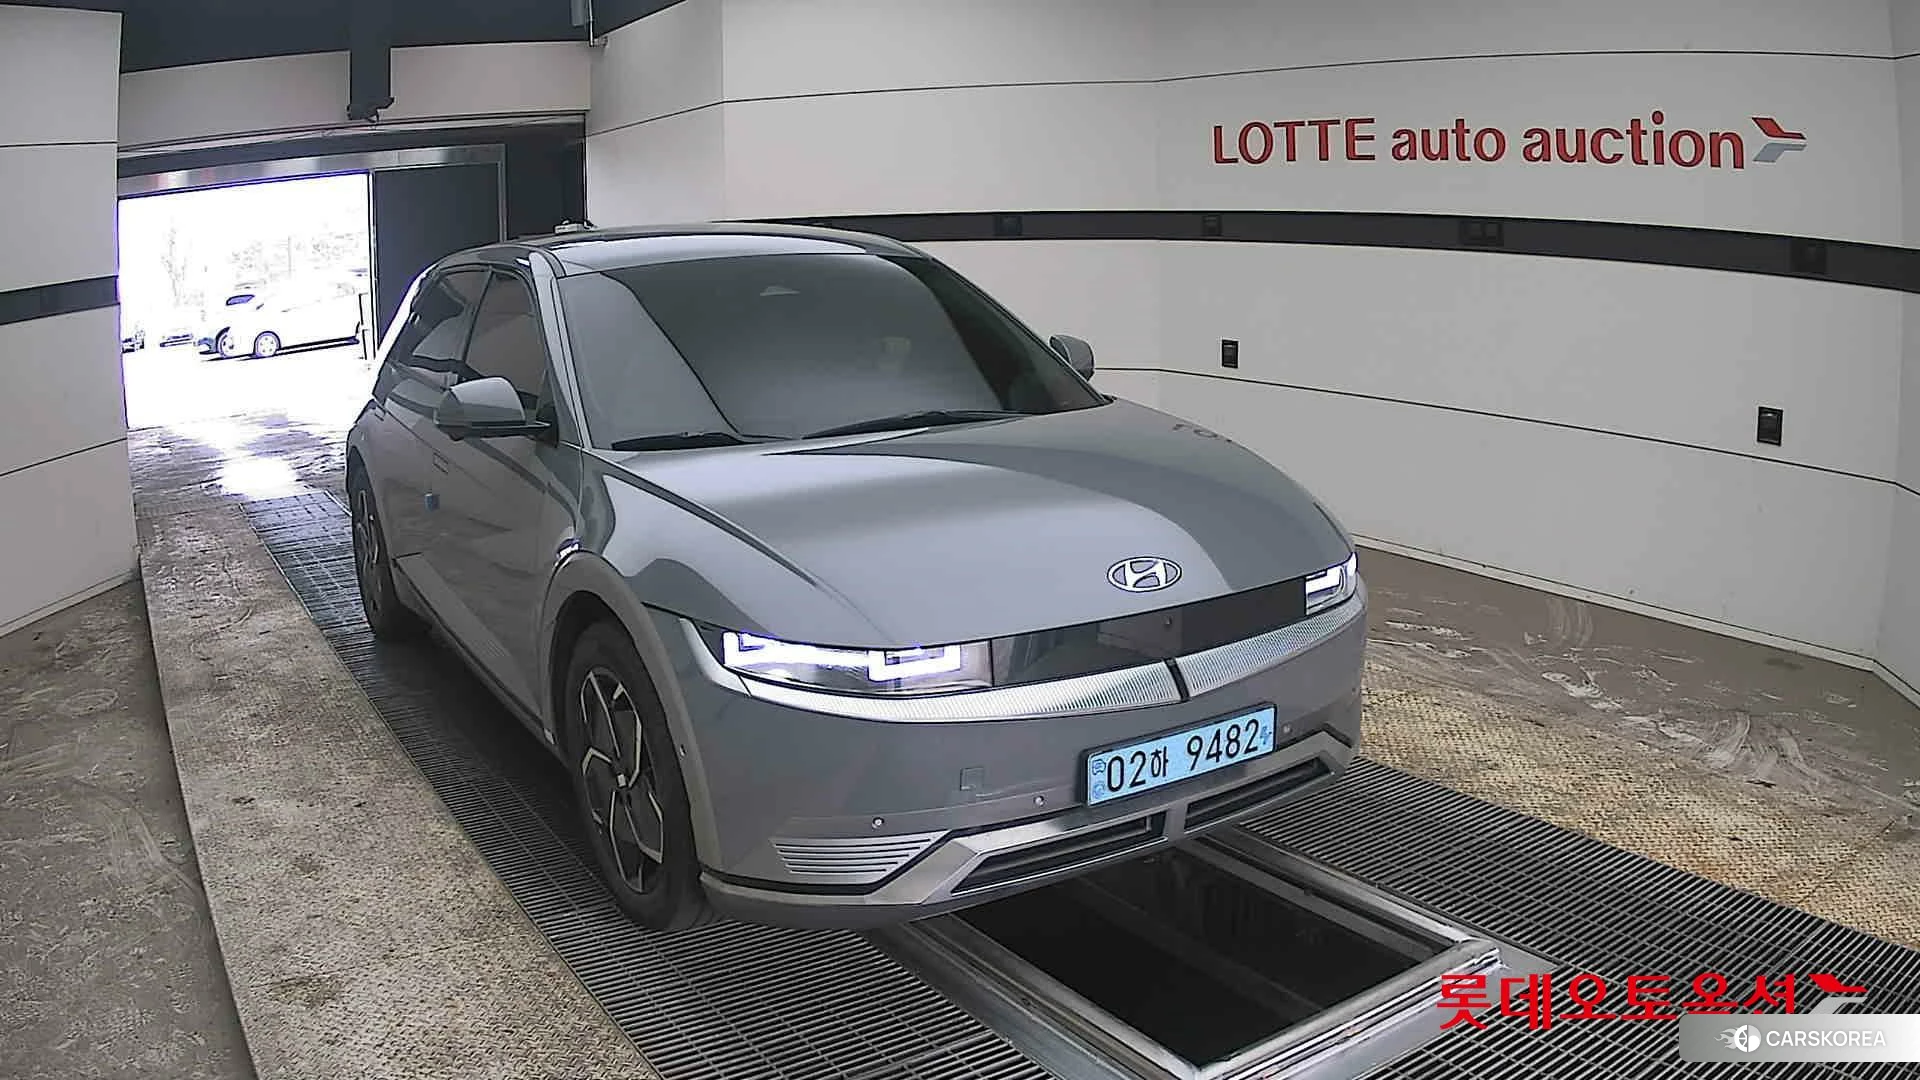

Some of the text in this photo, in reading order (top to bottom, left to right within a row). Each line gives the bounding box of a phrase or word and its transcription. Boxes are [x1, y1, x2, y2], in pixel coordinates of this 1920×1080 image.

[1212, 110, 1746, 170] LOTTE auto auction
[1107, 718, 1259, 792] 02하 9482
